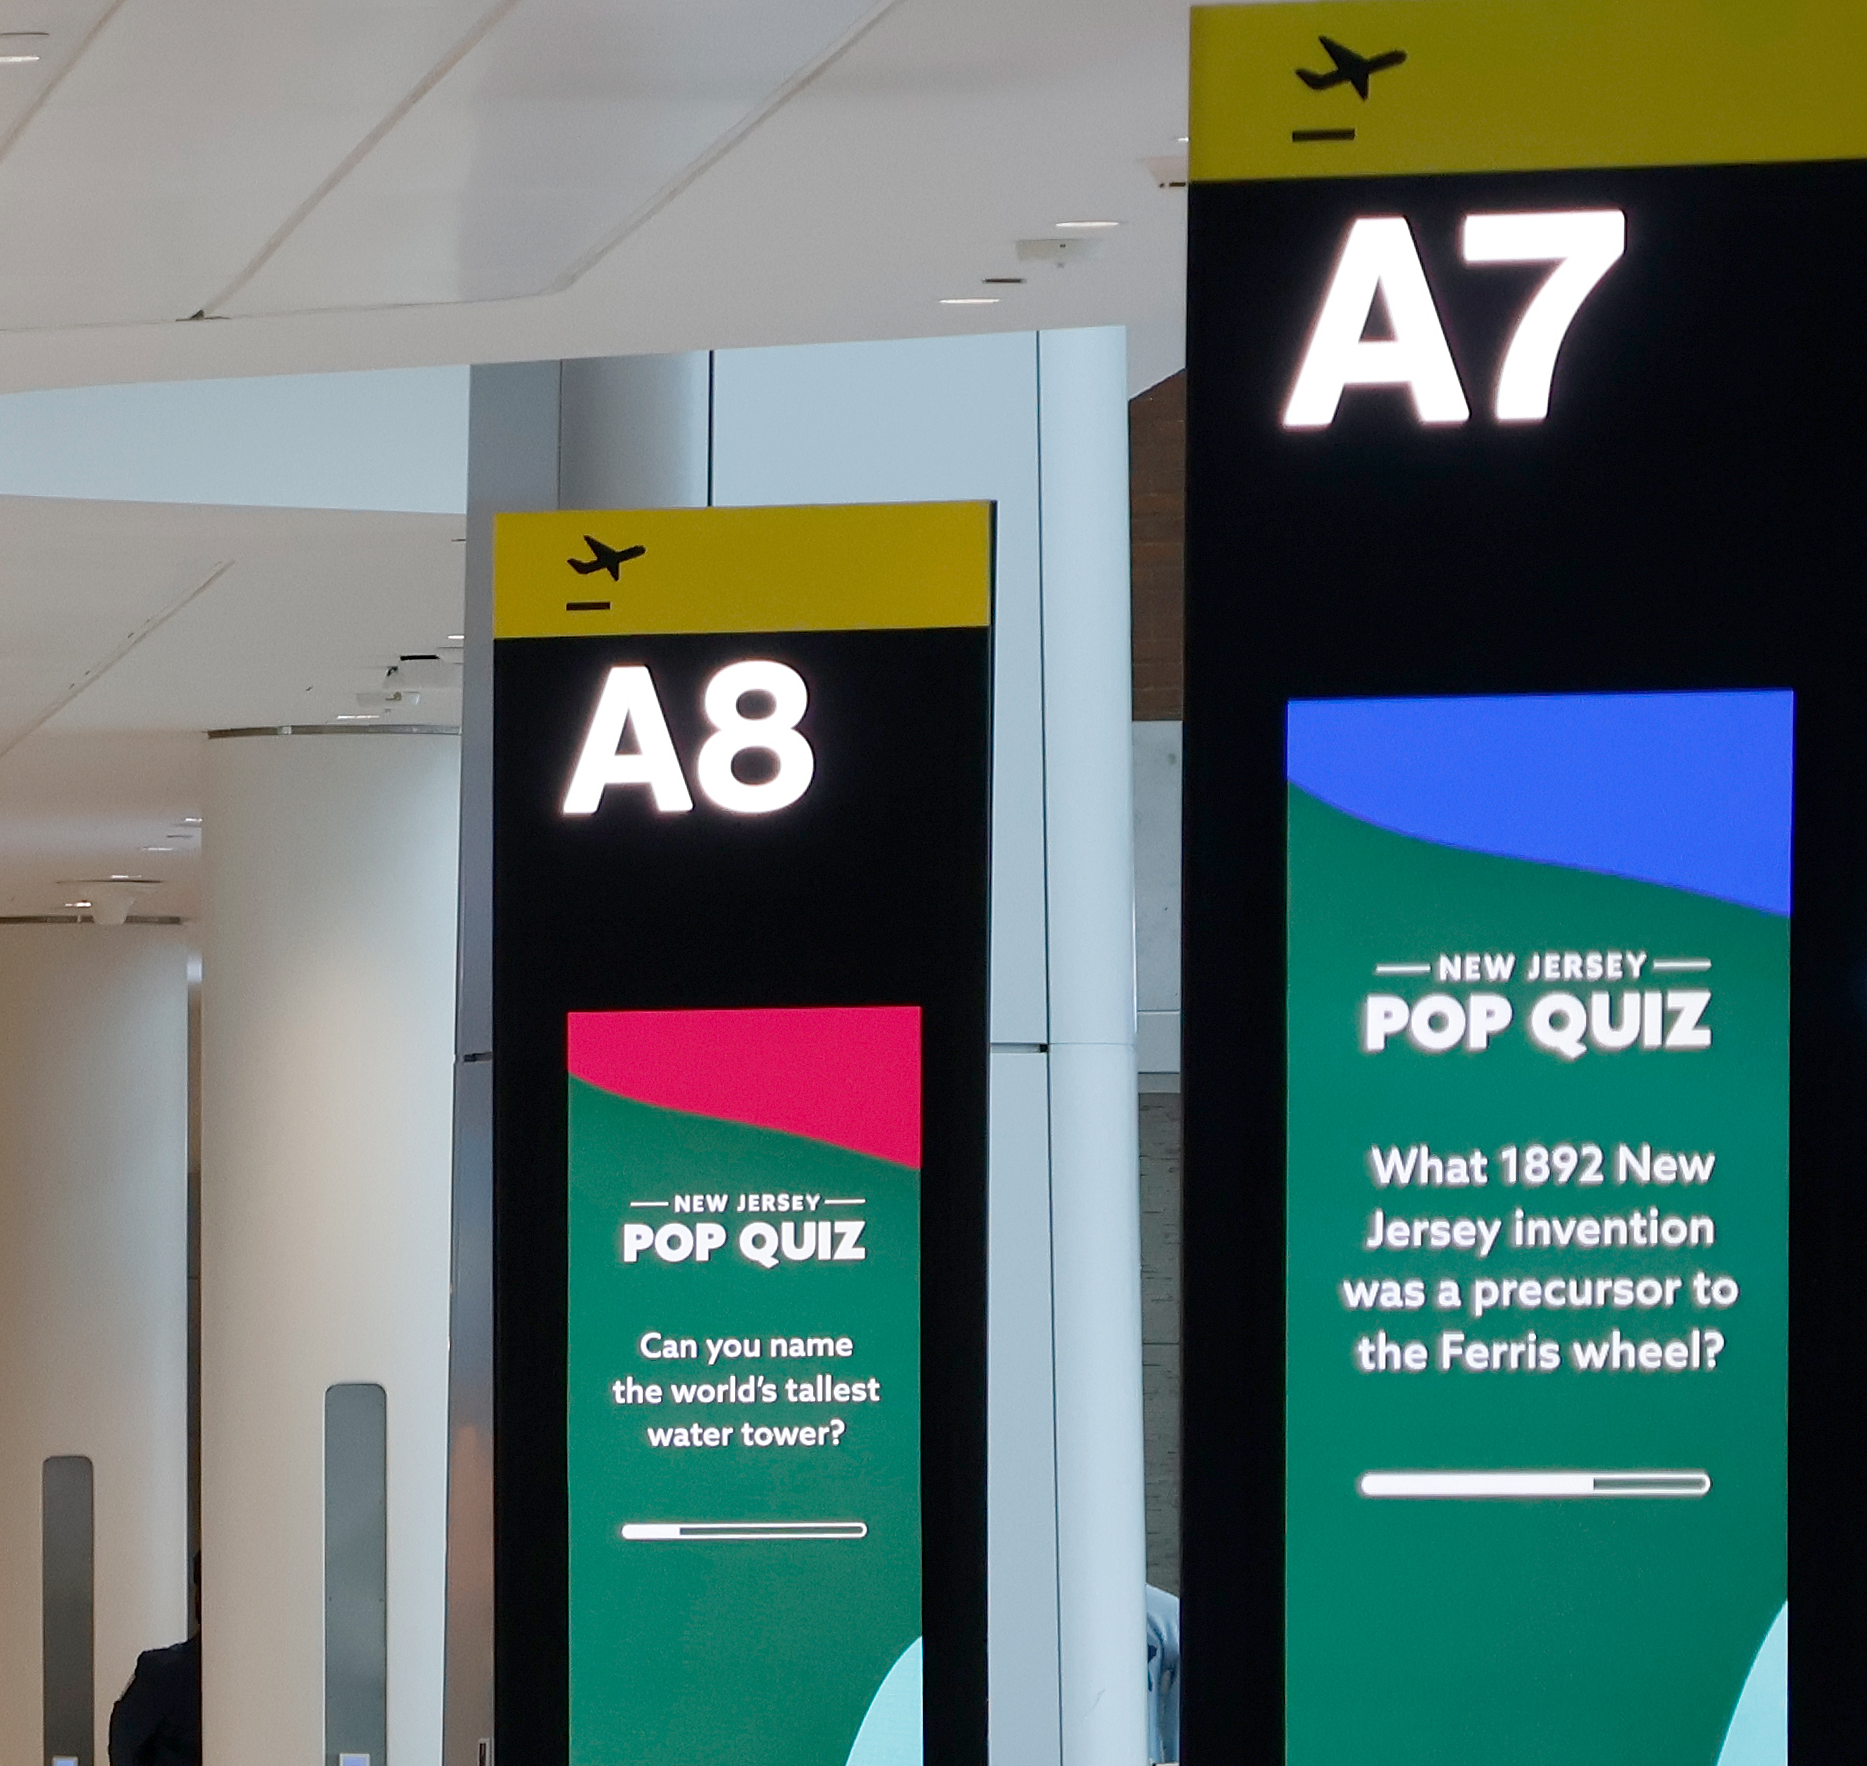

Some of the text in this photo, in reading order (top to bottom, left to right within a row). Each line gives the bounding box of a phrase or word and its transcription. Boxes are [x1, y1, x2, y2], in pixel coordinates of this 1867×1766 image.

[1282, 209, 1625, 429] A7
[562, 659, 814, 815] A8
[1437, 951, 1647, 982] NEW JERSEY
[1365, 990, 1712, 1060] POP QUIZ
[1370, 1143, 1716, 1186] What 1892 New
[674, 1193, 821, 1213] NEW JERSEY
[623, 1220, 866, 1269] POP QUIZ
[1365, 1206, 1714, 1258] Jersey invention
[1342, 1271, 1739, 1318] was a precursor to
[640, 1331, 854, 1365] Can you name
[1356, 1327, 1725, 1372] the Ferris wheel?
[611, 1374, 881, 1404] the world's tallest
[646, 1418, 845, 1447] water tower?
